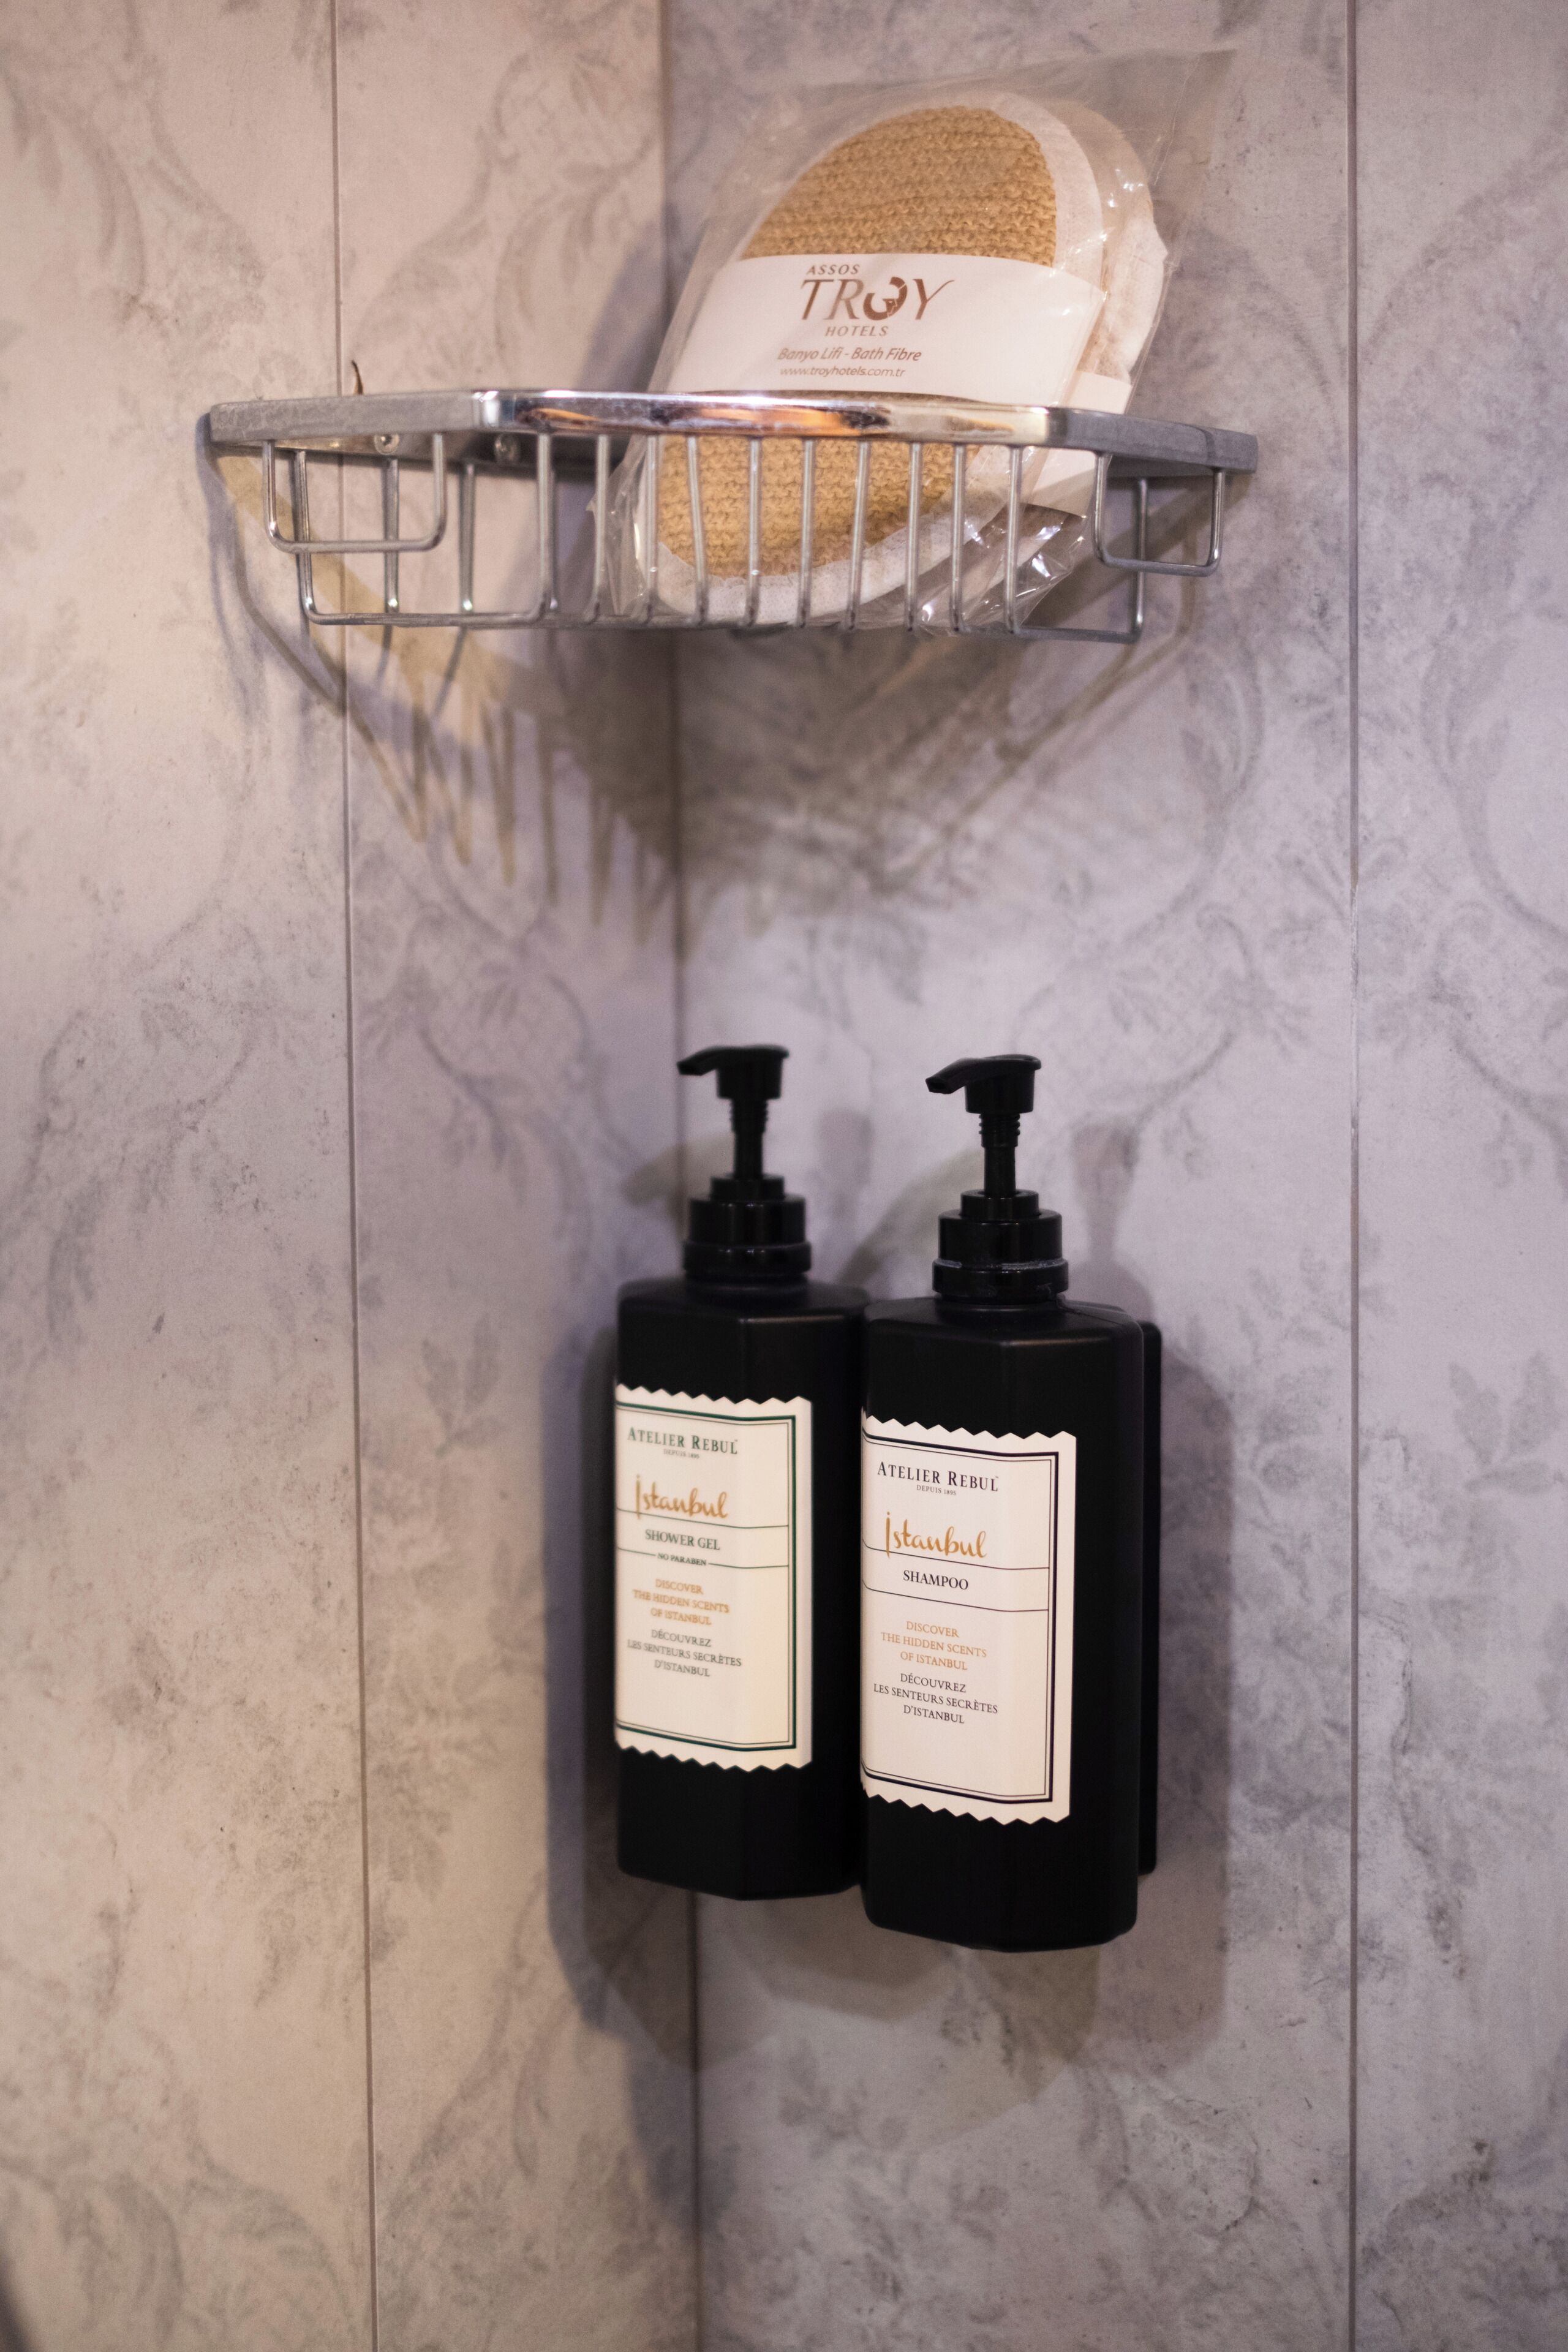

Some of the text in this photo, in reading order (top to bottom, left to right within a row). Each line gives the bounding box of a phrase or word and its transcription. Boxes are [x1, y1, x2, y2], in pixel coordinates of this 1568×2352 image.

[807, 265, 860, 275] ASSOS
[801, 277, 955, 320] TROY
[825, 326, 889, 336] HOTELS
[777, 348, 818, 361] Banyo
[821, 347, 843, 359] Lifi
[851, 348, 883, 360] Bath
[886, 349, 921, 361] Fibre
[780, 366, 905, 377] www.troyhotels.com.tr
[628, 1427, 684, 1448] ATELIER
[663, 1449, 686, 1458] DEPUIS
[877, 1461, 940, 1484] ATELIER
[916, 1485, 942, 1494] DEPUIS
[645, 1529, 720, 1550] SHOWER GEL
[671, 1555, 706, 1566] PARABEN
[655, 1579, 703, 1594] DISCOVER
[903, 1570, 968, 1590] SHAMPOO
[633, 1589, 729, 1613] THE HIDDEN SCENTS
[651, 1608, 711, 1625] OF ISTANBUL
[651, 1629, 711, 1647] DÉCOUVREZ
[907, 1621, 959, 1638] DISCOVER
[627, 1639, 741, 1667] LES SENTEURS SECRÈTES
[881, 1632, 987, 1657] THE HIDDEN SCENTS
[900, 1651, 967, 1670] OF ISTANBUL
[900, 1673, 967, 1693] DÉCOUVREZ
[873, 1684, 998, 1714] LES SENTEURS SECRÈTES
